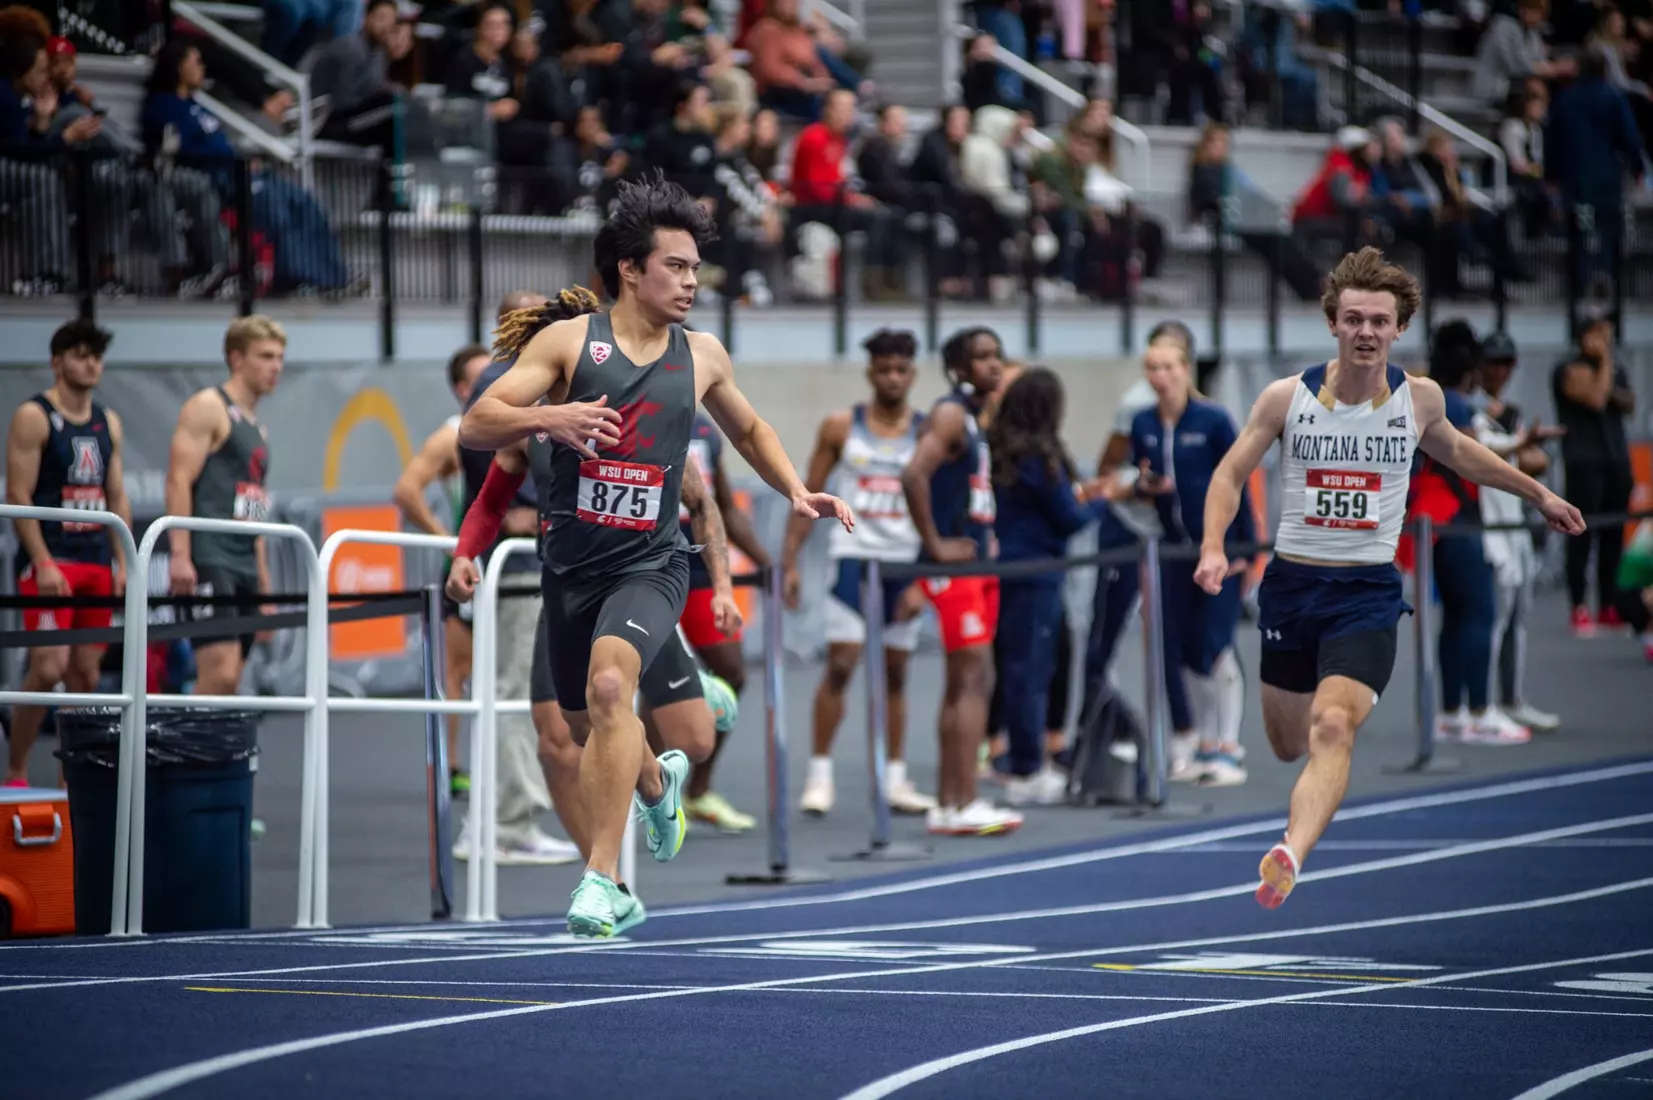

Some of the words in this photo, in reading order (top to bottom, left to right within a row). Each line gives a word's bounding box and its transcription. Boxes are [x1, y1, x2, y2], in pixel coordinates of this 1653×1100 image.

[1293, 434, 1359, 461] MONTANA
[1365, 436, 1407, 463] STATE
[599, 465, 621, 478] WSU
[624, 468, 648, 482] OPEN
[1322, 475, 1342, 486] WSU
[1344, 476, 1366, 487] OPEN
[591, 482, 649, 518] 875
[1316, 490, 1368, 519] 559
